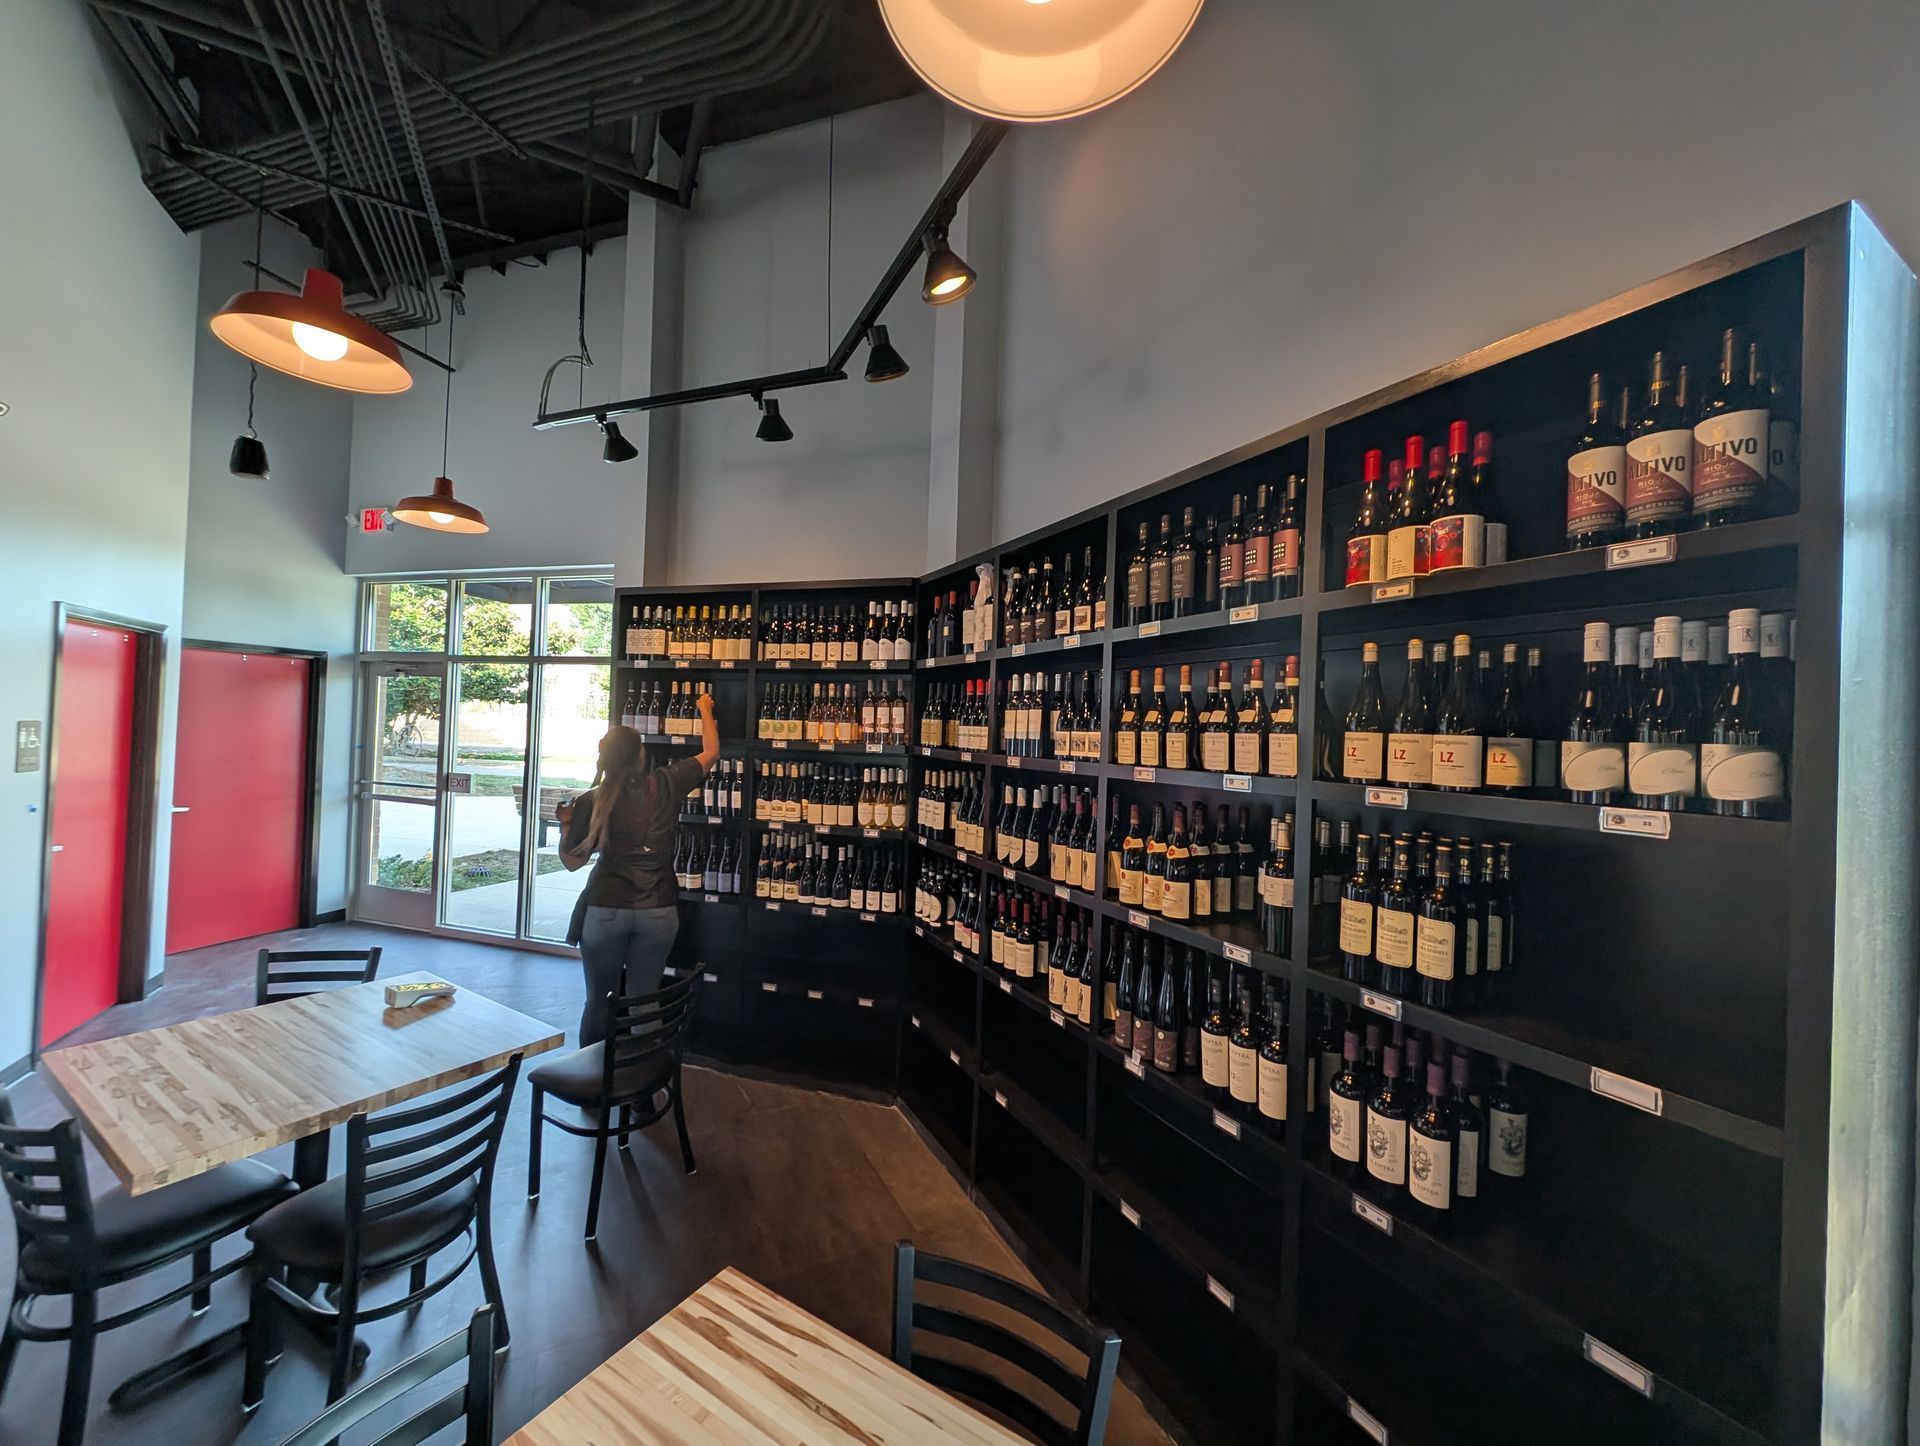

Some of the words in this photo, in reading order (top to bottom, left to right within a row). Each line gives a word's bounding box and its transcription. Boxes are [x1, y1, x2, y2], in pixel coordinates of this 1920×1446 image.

[1347, 747, 1357, 757] LZ
[1394, 749, 1406, 760] LZ
[1440, 751, 1454, 762] LZ
[1492, 752, 1507, 763] LZ
[451, 777, 468, 788] EXIT
